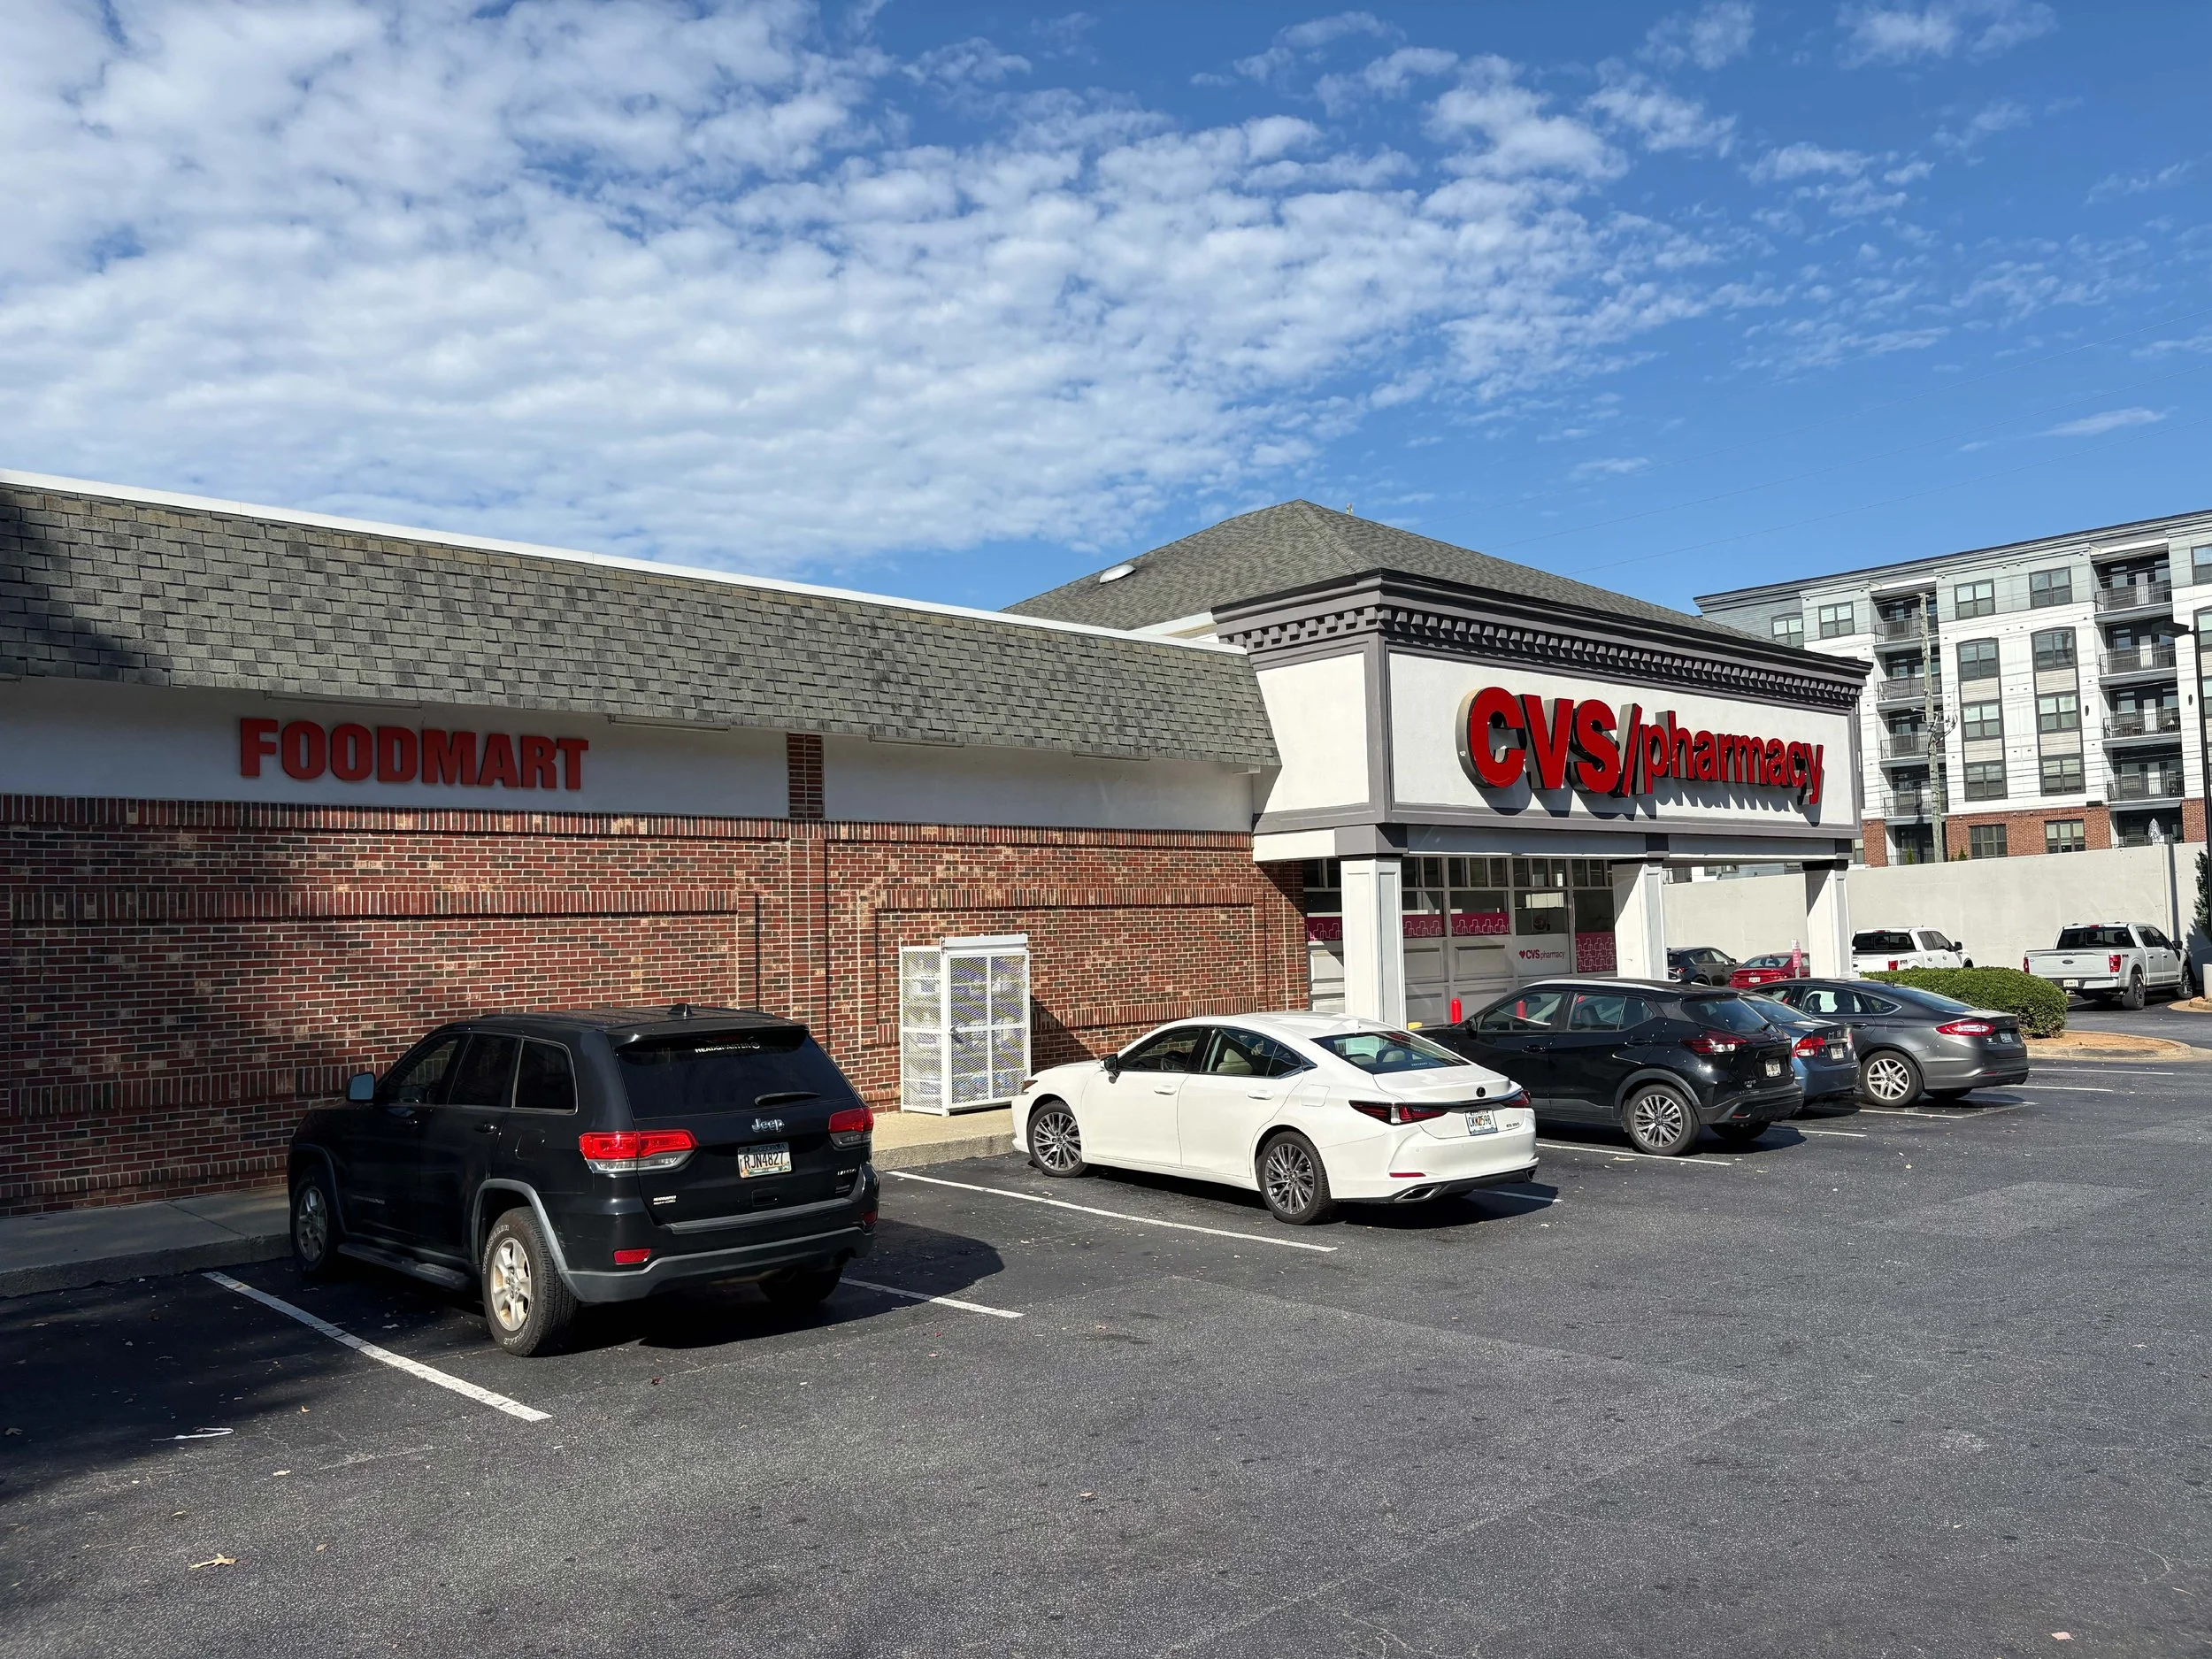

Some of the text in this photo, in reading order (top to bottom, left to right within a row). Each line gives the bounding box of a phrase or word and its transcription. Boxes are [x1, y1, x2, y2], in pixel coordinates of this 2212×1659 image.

[240, 717, 589, 790] FOODMART
[1525, 949, 1565, 960] CVS pharmacy
[751, 1118, 785, 1133] Jeep
[743, 1150, 784, 1170] RJN4827
